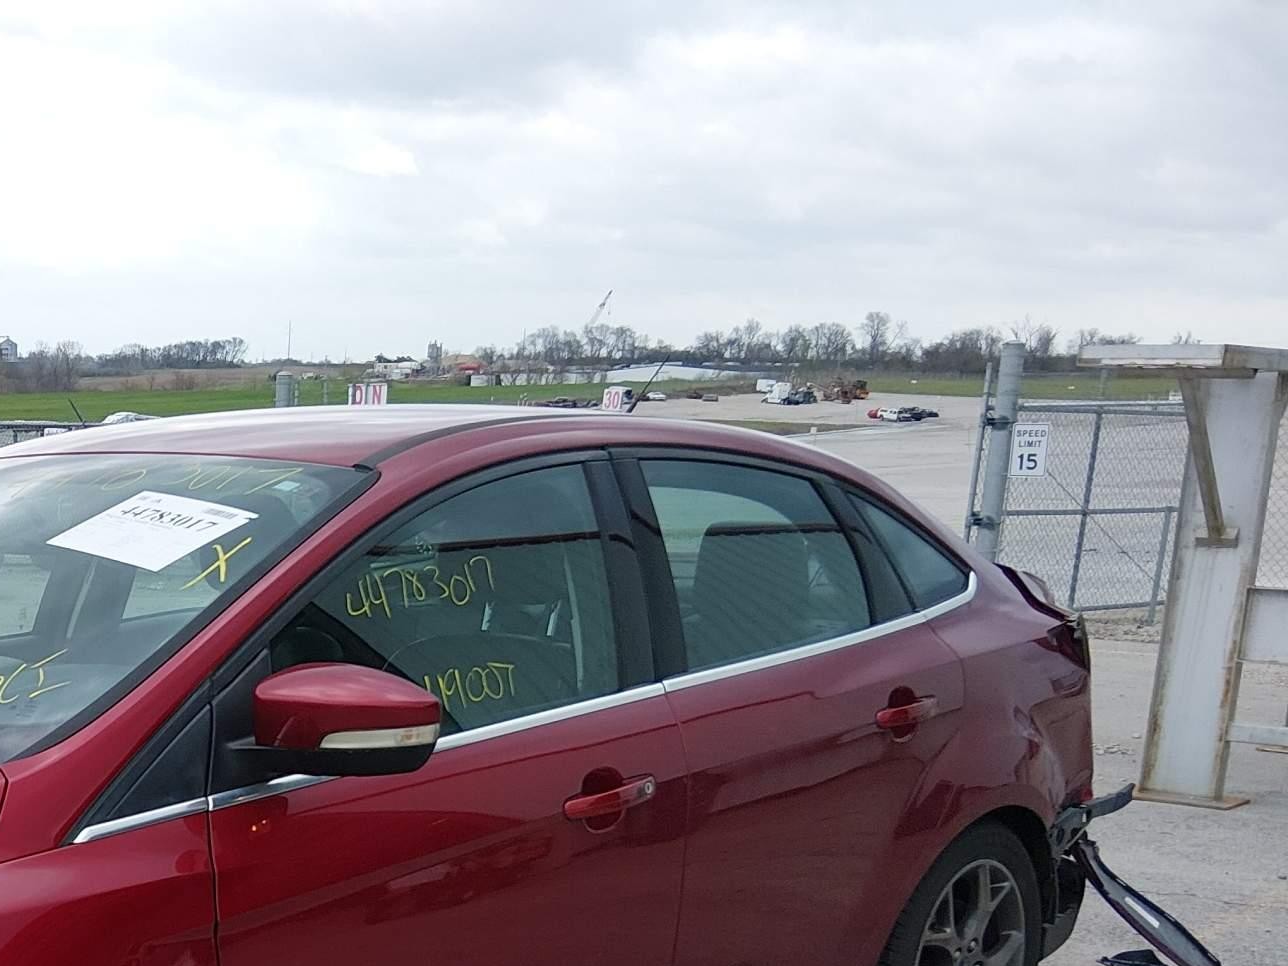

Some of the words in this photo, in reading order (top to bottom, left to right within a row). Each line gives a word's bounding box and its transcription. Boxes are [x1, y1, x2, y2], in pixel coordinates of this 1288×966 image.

[1016, 429, 1047, 438] SPEED
[1018, 440, 1042, 448] LIMIT
[1017, 453, 1038, 470] 15
[120, 505, 219, 533] 44783017
[346, 556, 495, 618] 44783017
